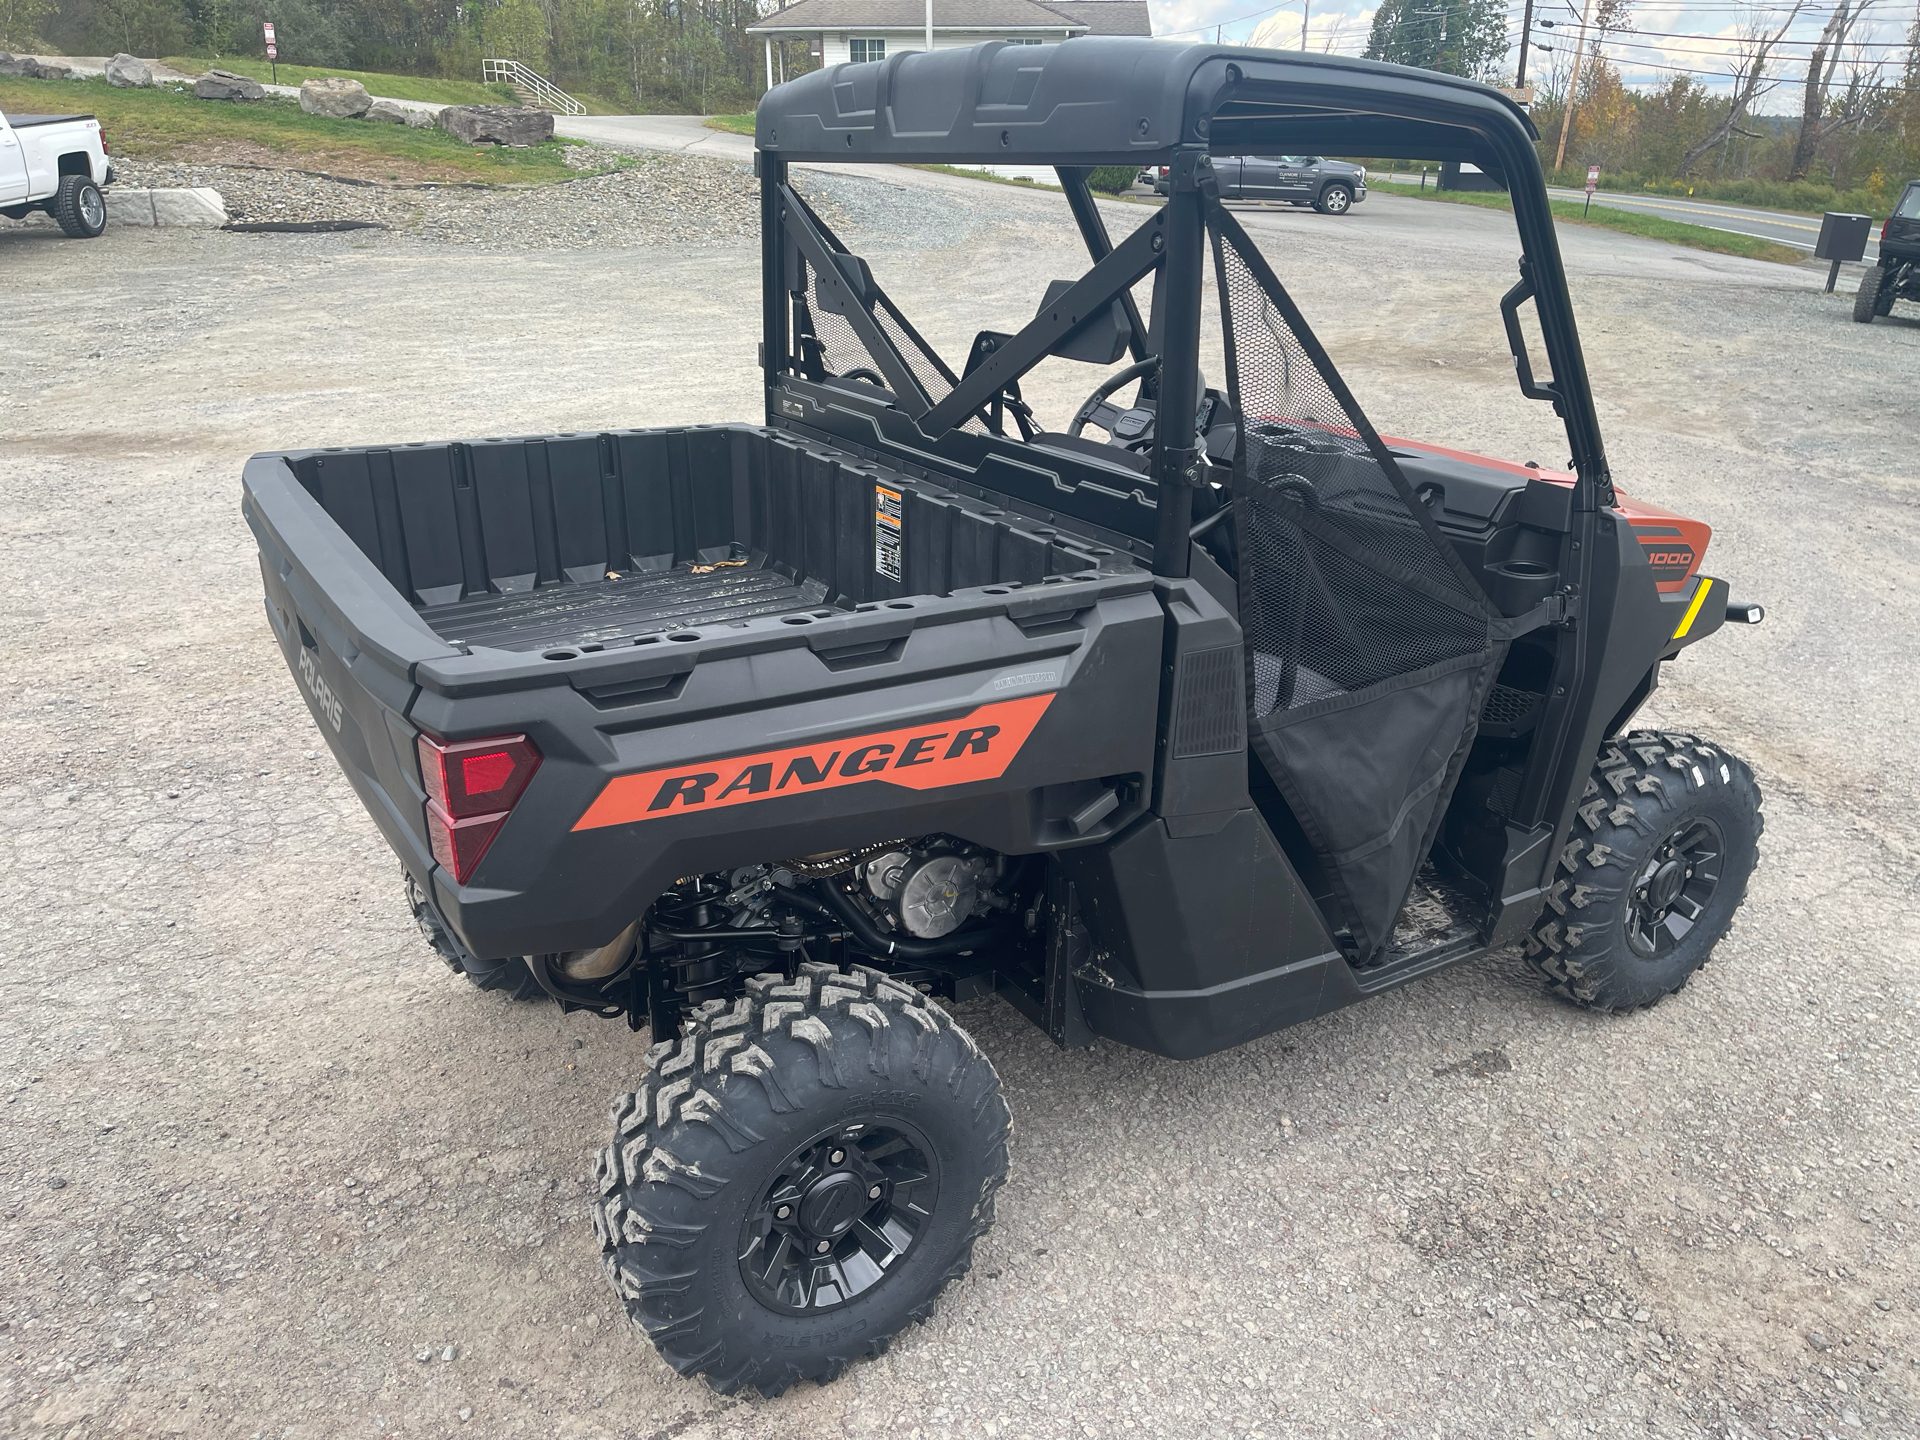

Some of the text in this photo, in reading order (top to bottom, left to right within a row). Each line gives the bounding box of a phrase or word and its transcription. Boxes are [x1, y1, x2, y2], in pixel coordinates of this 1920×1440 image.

[1506, 90, 1526, 99] AZA
[1648, 552, 1693, 565] 1000
[299, 644, 343, 733] POLARIS
[994, 671, 1057, 690] HAMLIN MOTORSPORTS
[646, 724, 1001, 813] RANGER
